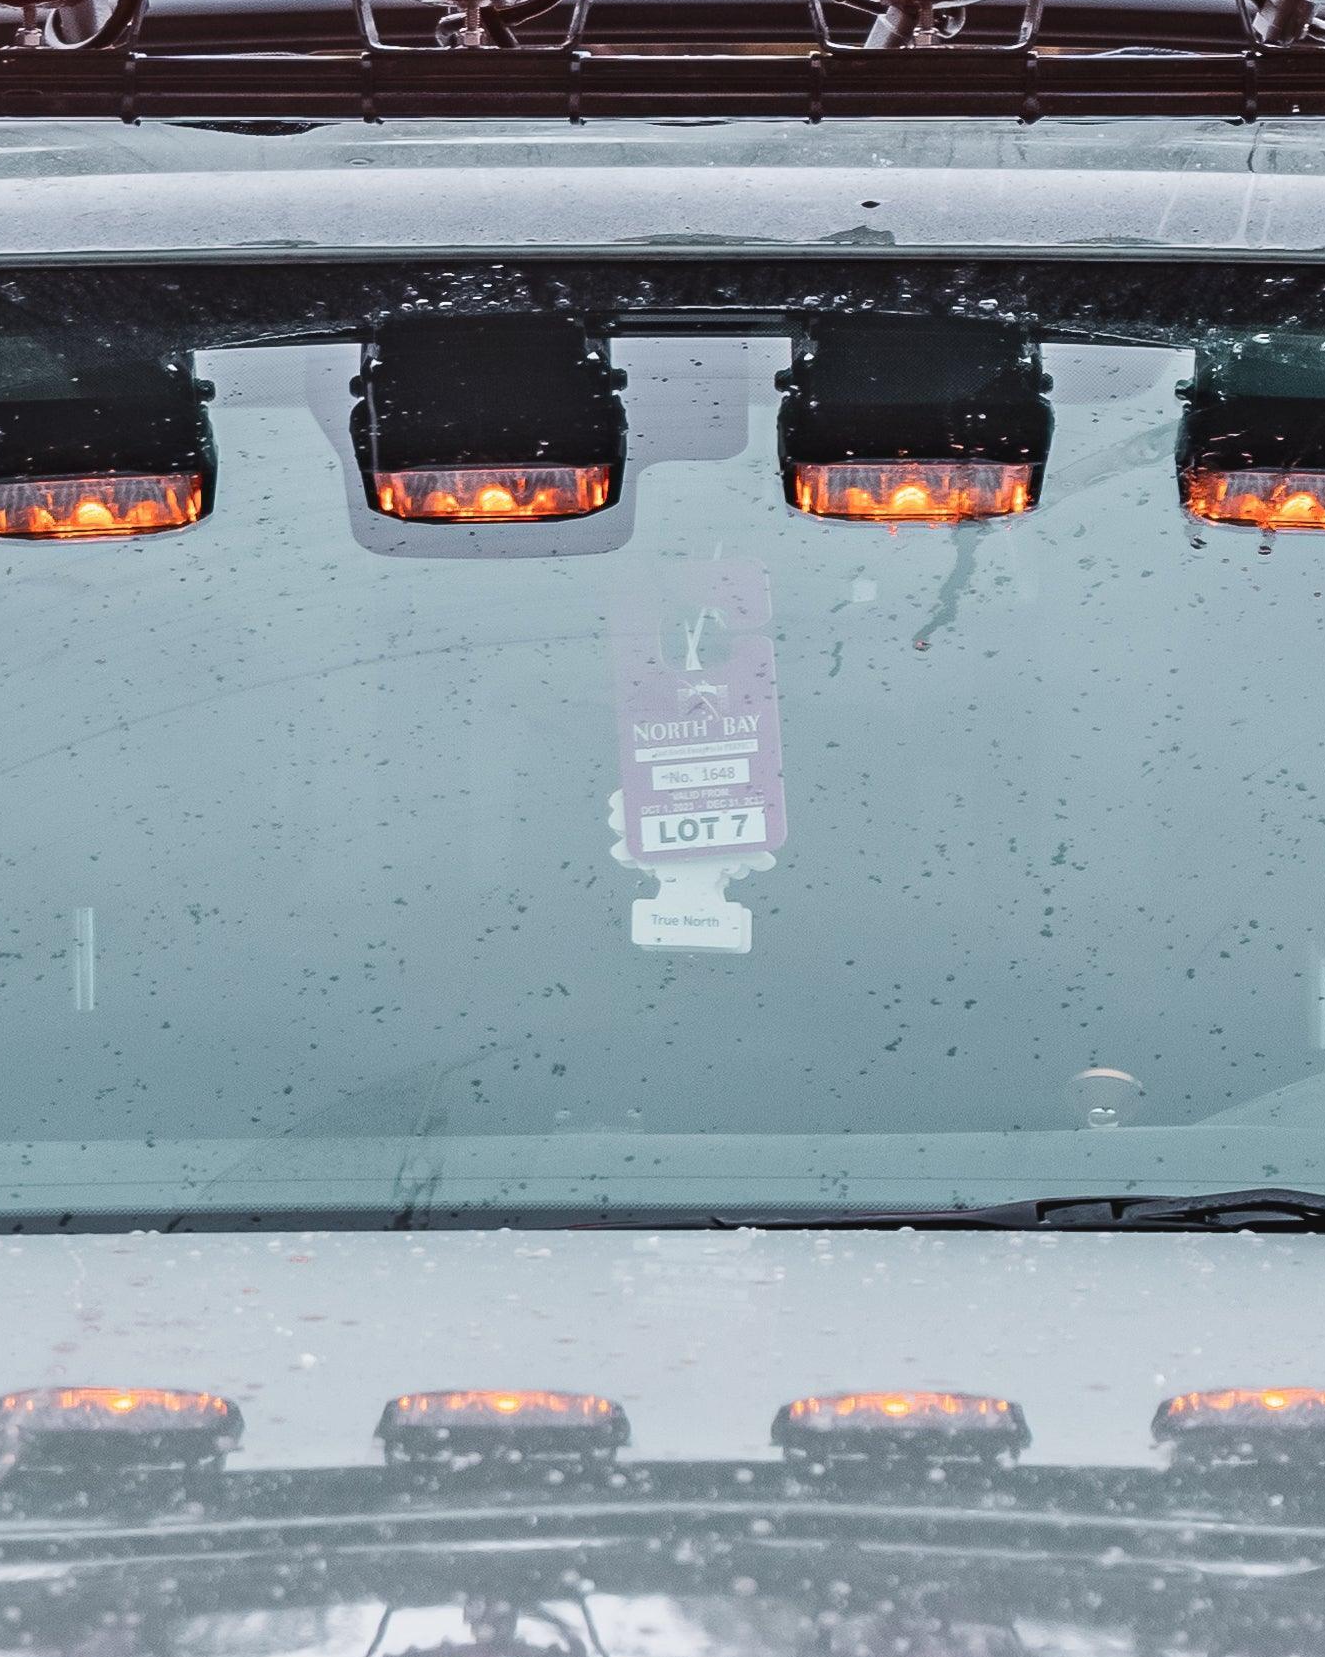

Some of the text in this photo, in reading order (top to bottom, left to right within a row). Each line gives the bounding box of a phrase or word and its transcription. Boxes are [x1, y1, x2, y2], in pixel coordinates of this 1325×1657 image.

[634, 715, 759, 742] NORTH BAY
[702, 766, 736, 781] 1648
[659, 814, 748, 843] LOT 7
[651, 914, 720, 928] True North
